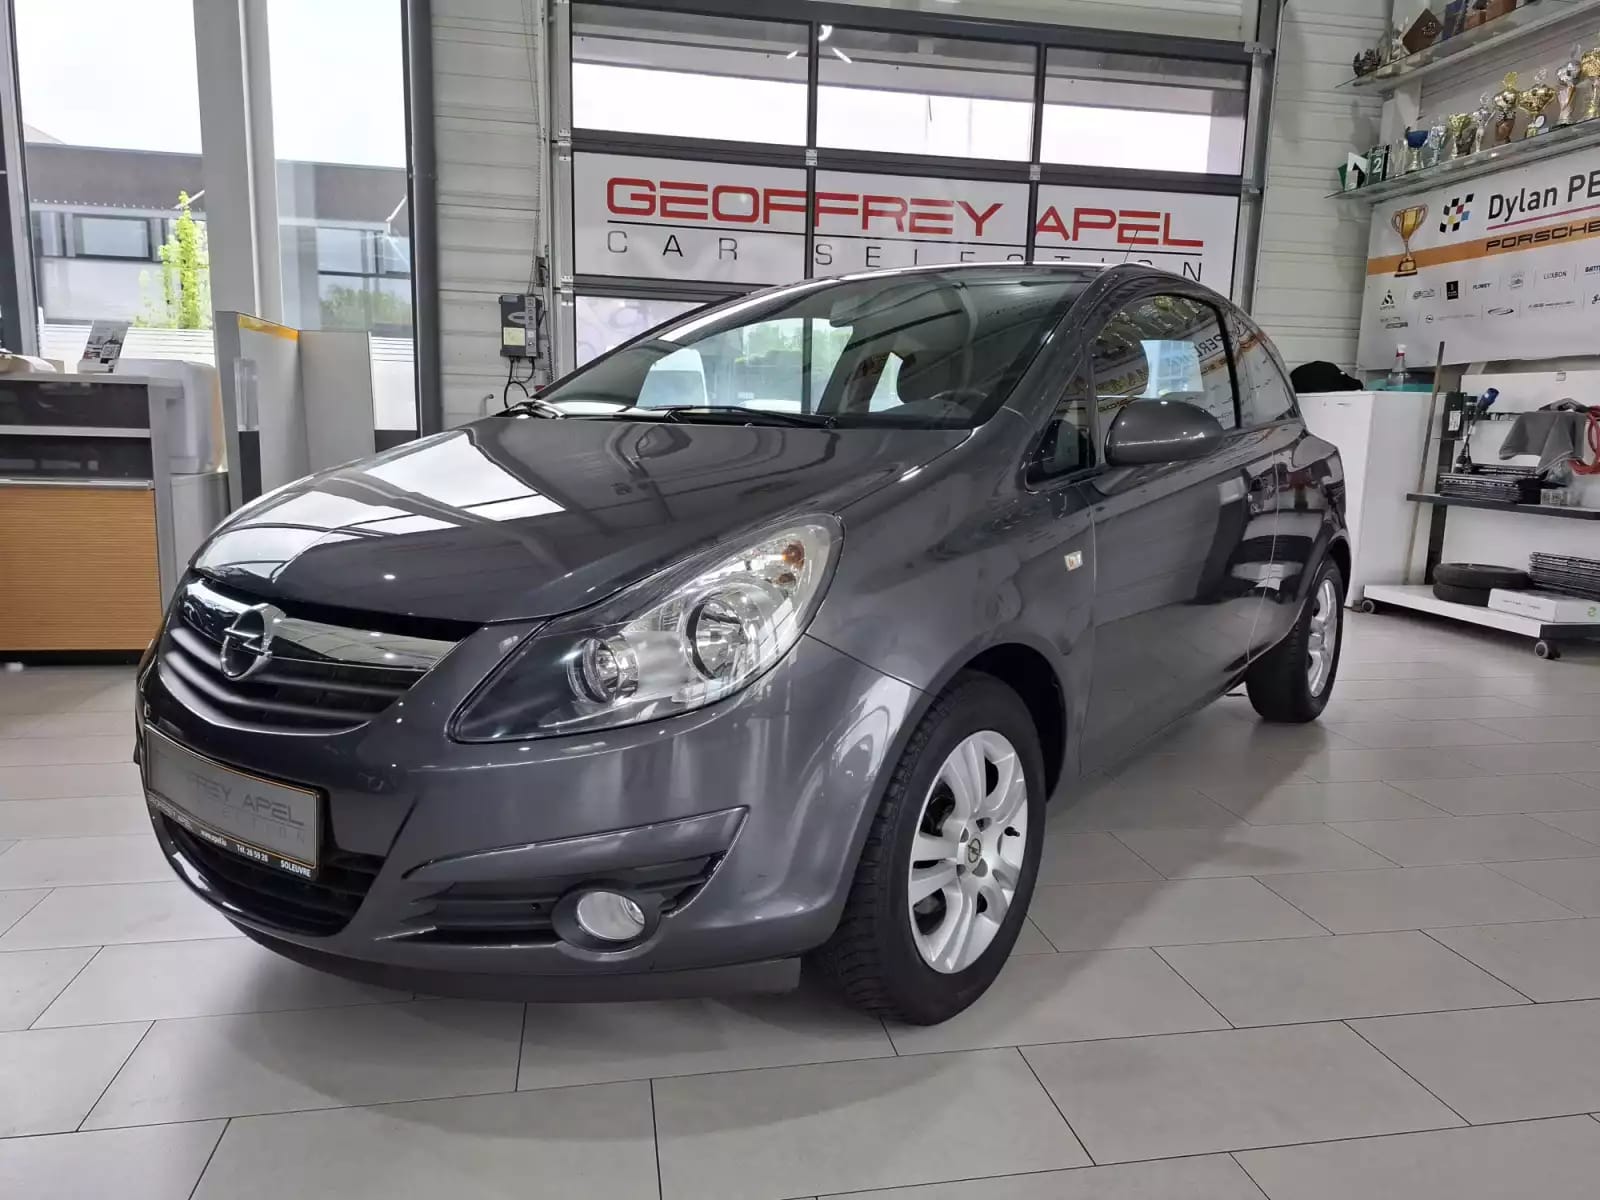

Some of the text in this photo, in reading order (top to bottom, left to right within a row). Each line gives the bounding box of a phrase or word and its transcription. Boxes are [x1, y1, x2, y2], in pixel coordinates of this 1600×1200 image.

[607, 177, 1204, 247] GEOFFREY APEL
[1488, 187, 1558, 222] Dylan
[607, 230, 738, 261] CAR
[1486, 220, 1600, 251] PORSCHE
[242, 793, 304, 826] APEL
[280, 859, 311, 878] SOLEUVRE
